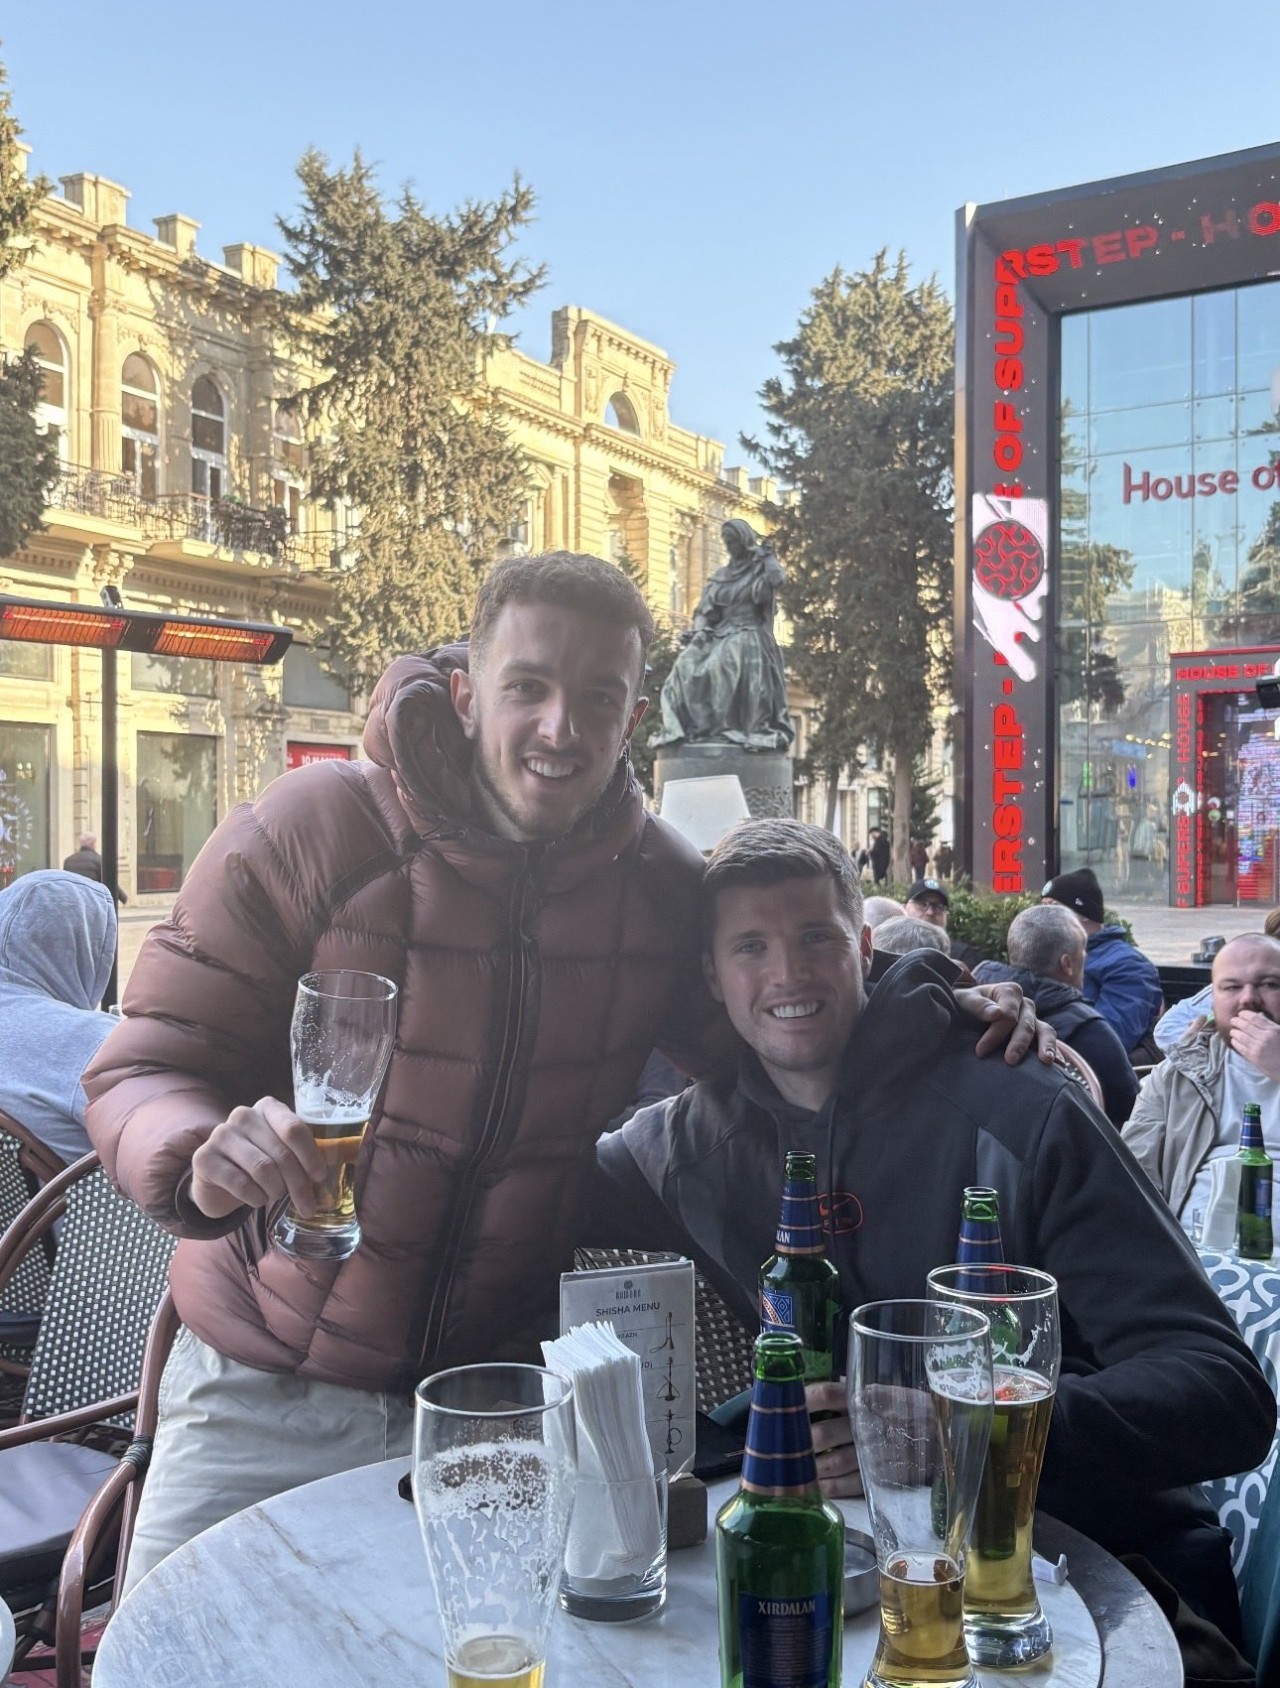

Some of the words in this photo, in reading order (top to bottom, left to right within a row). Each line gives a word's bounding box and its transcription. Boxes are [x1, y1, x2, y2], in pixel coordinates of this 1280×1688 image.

[994, 401, 1024, 472] OF
[1123, 461, 1240, 505] House
[1176, 665, 1239, 681] HOUSE
[595, 1304, 631, 1317] SHISHA
[633, 1301, 661, 1312] MENU
[758, 1600, 816, 1615] XIRDALAN
